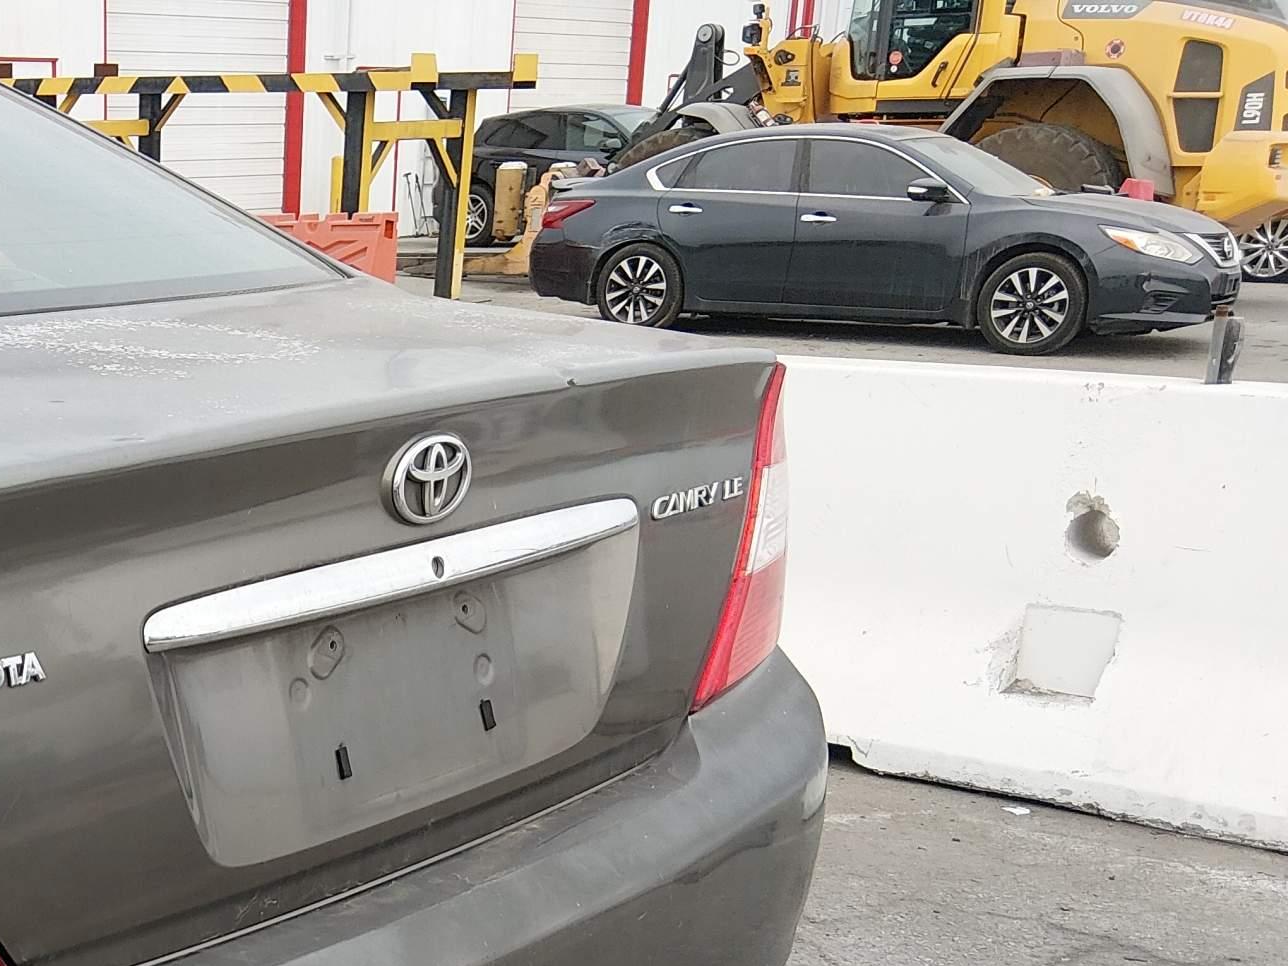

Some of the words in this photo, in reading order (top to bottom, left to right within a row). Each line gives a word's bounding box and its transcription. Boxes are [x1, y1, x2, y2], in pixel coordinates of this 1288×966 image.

[1072, 4, 1138, 14] VOLVO
[1241, 92, 1265, 125] L90H
[651, 481, 719, 520] CAMRY
[722, 476, 744, 500] LE
